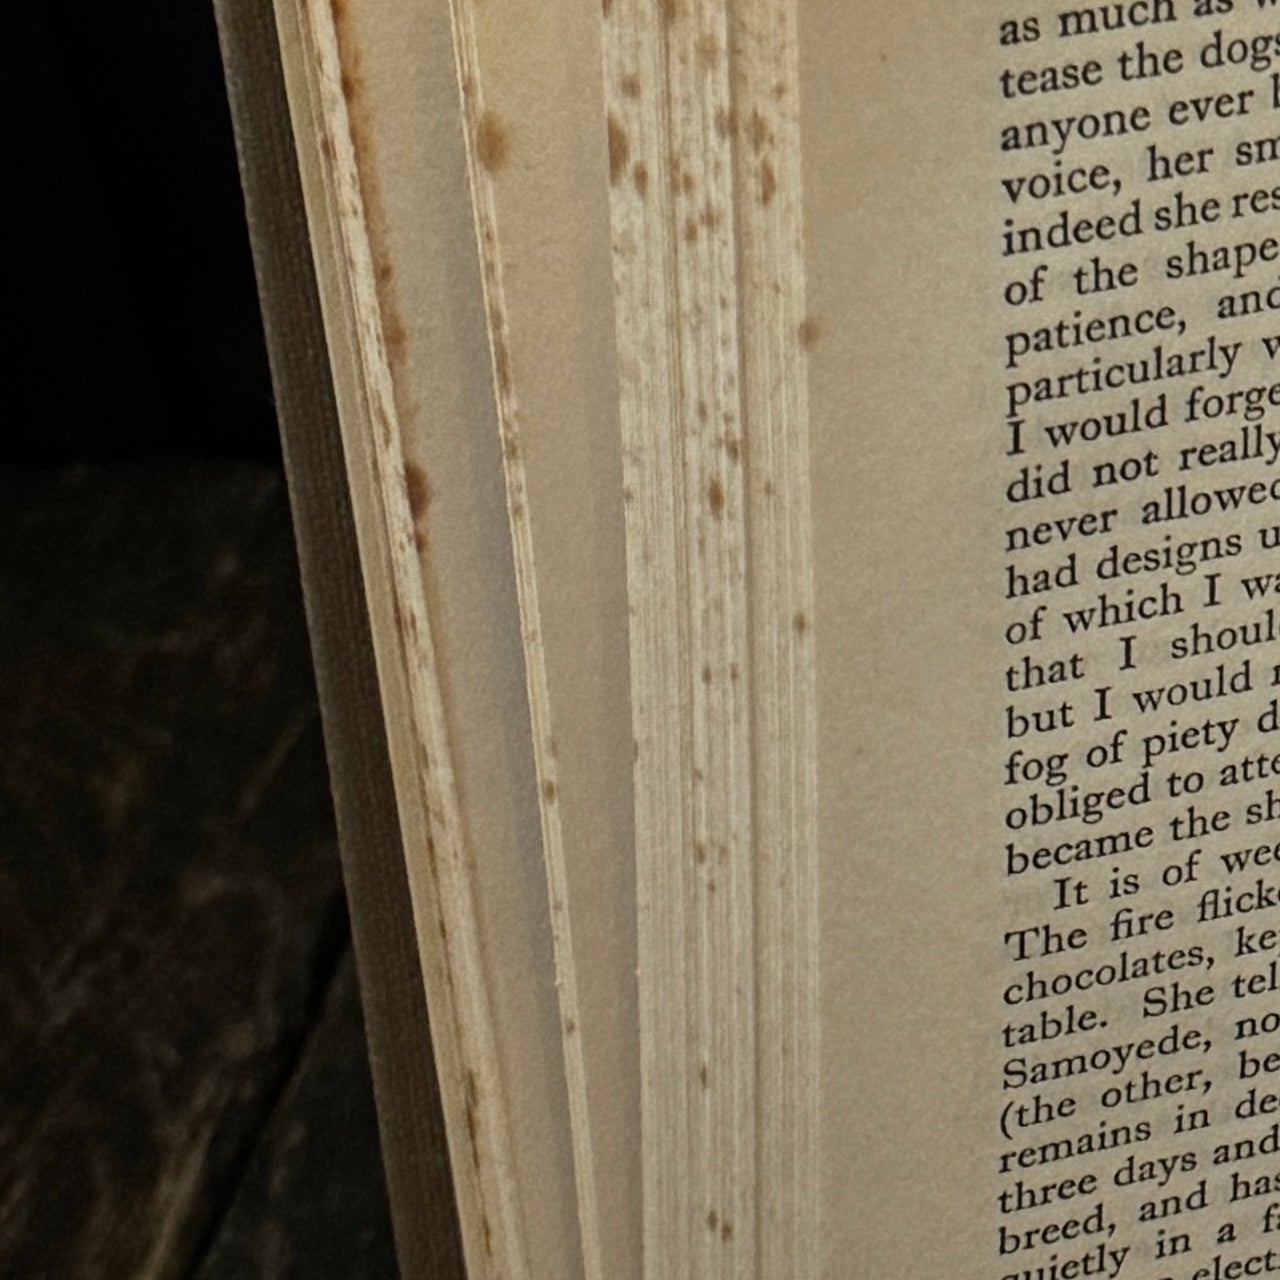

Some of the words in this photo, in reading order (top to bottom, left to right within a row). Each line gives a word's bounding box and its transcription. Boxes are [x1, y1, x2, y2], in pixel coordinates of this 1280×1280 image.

[999, 16, 1041, 46] as
[1004, 306, 1187, 370] patience,
[1004, 552, 1080, 600] had
[1095, 533, 1243, 580] designs
[1004, 826, 1154, 877] became
[1168, 805, 1231, 842] the
[998, 1201, 1117, 1257] breed,
[1138, 1178, 1210, 1223] and
